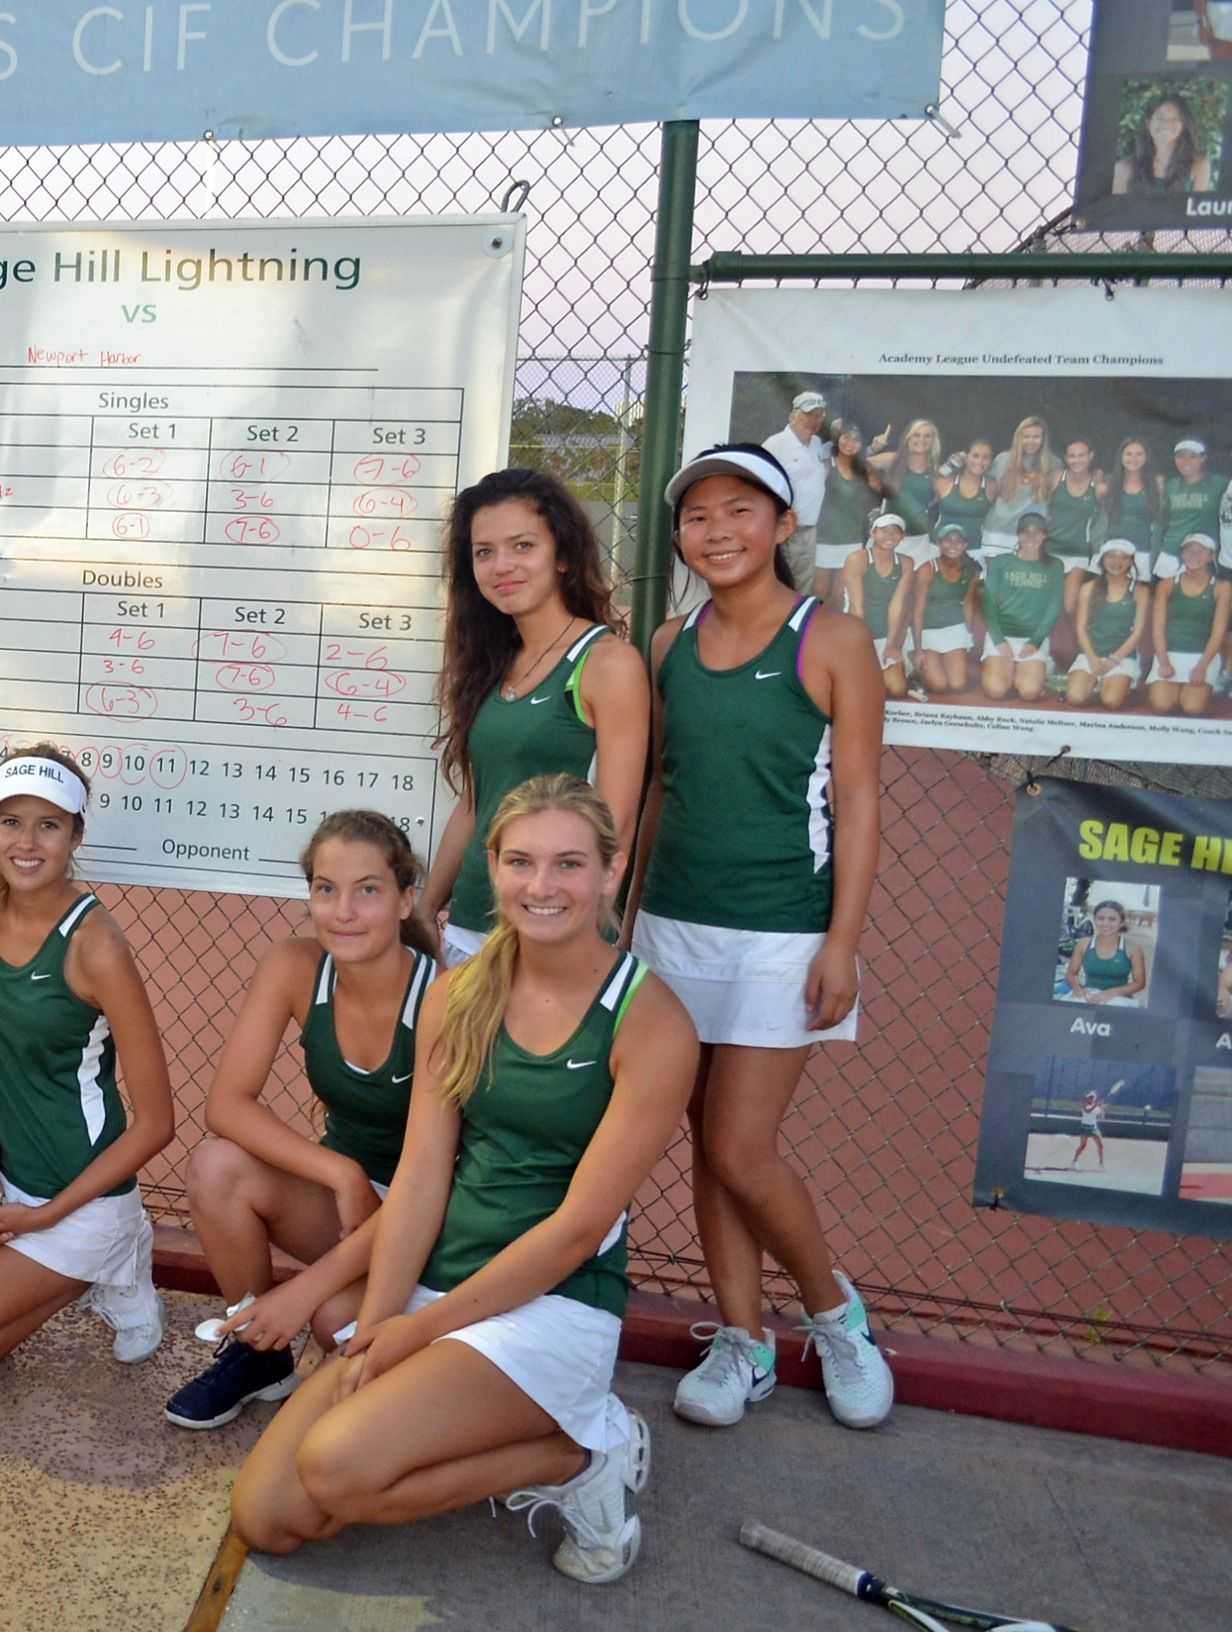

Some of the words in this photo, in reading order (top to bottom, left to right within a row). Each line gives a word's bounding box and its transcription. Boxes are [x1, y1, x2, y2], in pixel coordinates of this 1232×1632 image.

[72, 5, 207, 74] CIF
[266, 0, 905, 68] CHAMPIONS
[54, 249, 121, 282] Hill
[141, 248, 361, 290] Lightning
[878, 353, 932, 365] Academy
[935, 354, 979, 366] League
[982, 354, 1052, 365] Undefeated
[1056, 354, 1089, 364] Team
[1092, 354, 1164, 366] Champions
[99, 392, 168, 413] Singles
[128, 423, 159, 439] Set
[169, 424, 176, 439] 1
[247, 425, 280, 441] Set
[287, 426, 299, 442] 2
[372, 427, 405, 444] Set
[414, 428, 426, 444] 3
[82, 569, 163, 589] Doubles
[117, 600, 148, 618] Set
[157, 602, 164, 619] 1
[234, 606, 267, 624] Set
[274, 608, 286, 625] 2
[359, 612, 392, 630] Set
[400, 614, 412, 631] 3
[103, 658, 145, 674] 3-6
[5, 764, 35, 778] SAGE
[38, 766, 65, 784] HILL
[81, 752, 92, 768] 8
[102, 753, 113, 770] 9
[124, 755, 145, 772] 10
[157, 757, 176, 774] 11
[189, 759, 210, 776] 12
[223, 762, 243, 779] 13
[255, 764, 277, 781] 14
[289, 766, 310, 783] 15
[323, 769, 345, 787] 16
[357, 772, 379, 789] 17
[392, 774, 414, 791] 18
[100, 794, 110, 809] 9
[122, 796, 142, 812] 10
[154, 798, 172, 814] 11
[186, 801, 207, 817] 12
[220, 803, 240, 819] 13
[252, 806, 274, 822] 14
[286, 808, 307, 824] 15
[162, 838, 249, 862] Opponent
[1079, 819, 1184, 867] SAGE
[1070, 1017, 1111, 1037] Ava
